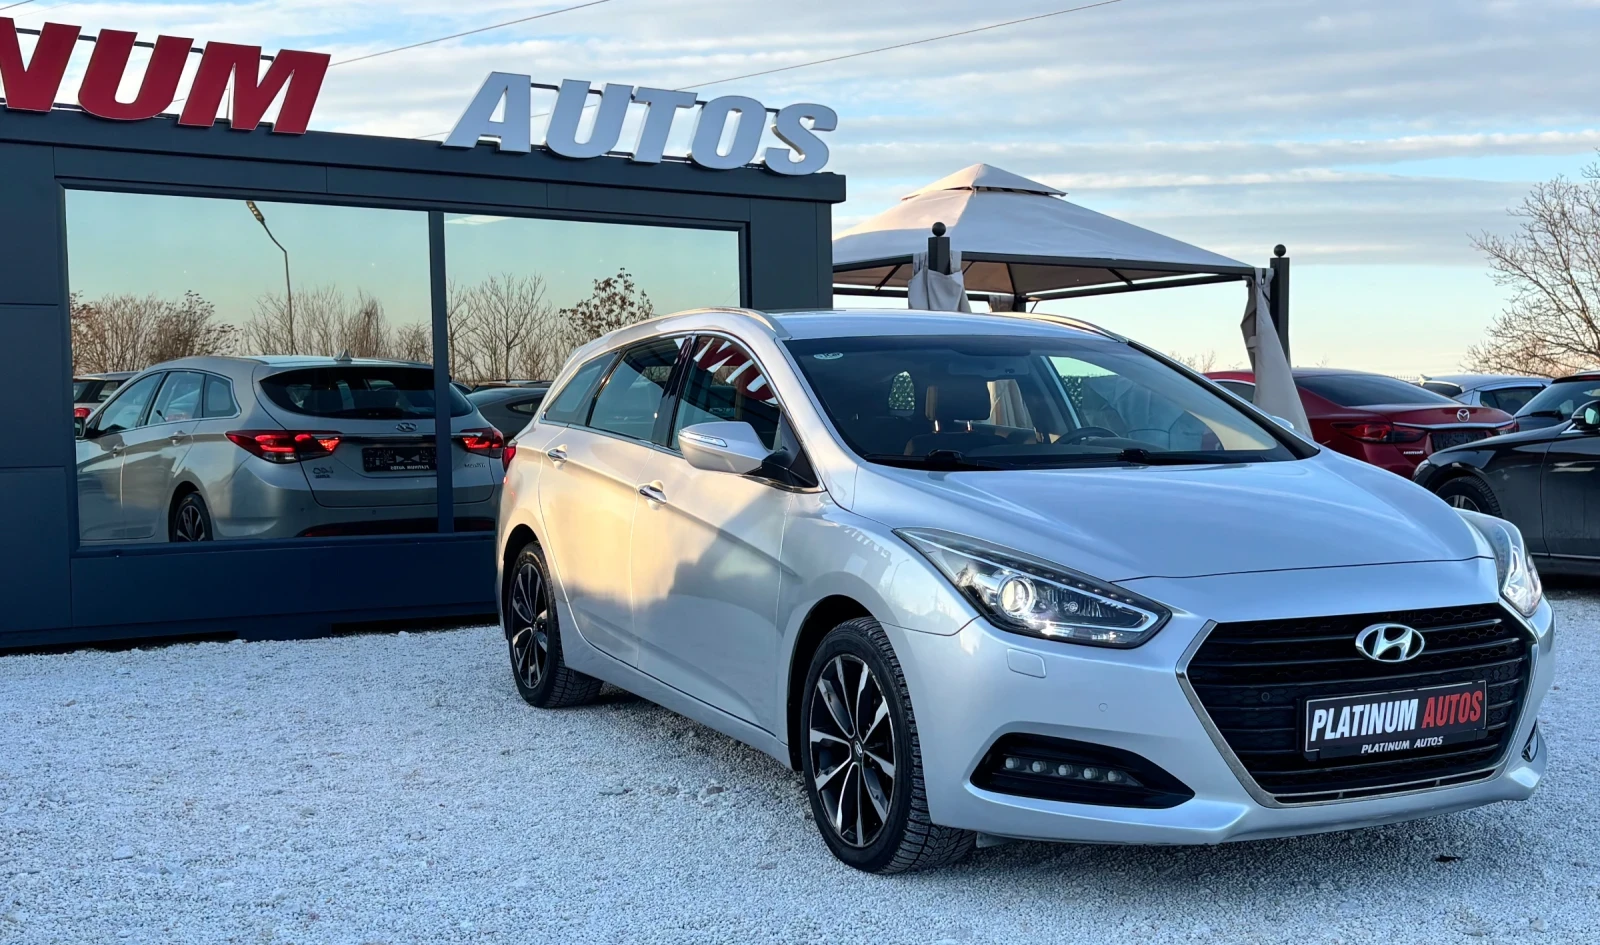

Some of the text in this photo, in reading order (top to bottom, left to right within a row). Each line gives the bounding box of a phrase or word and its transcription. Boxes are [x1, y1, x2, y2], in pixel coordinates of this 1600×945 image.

[441, 71, 838, 175] AUTOS
[1310, 690, 1483, 741] PLATINUM AUTOS
[1361, 736, 1444, 754] PLATINUM AUTOS
